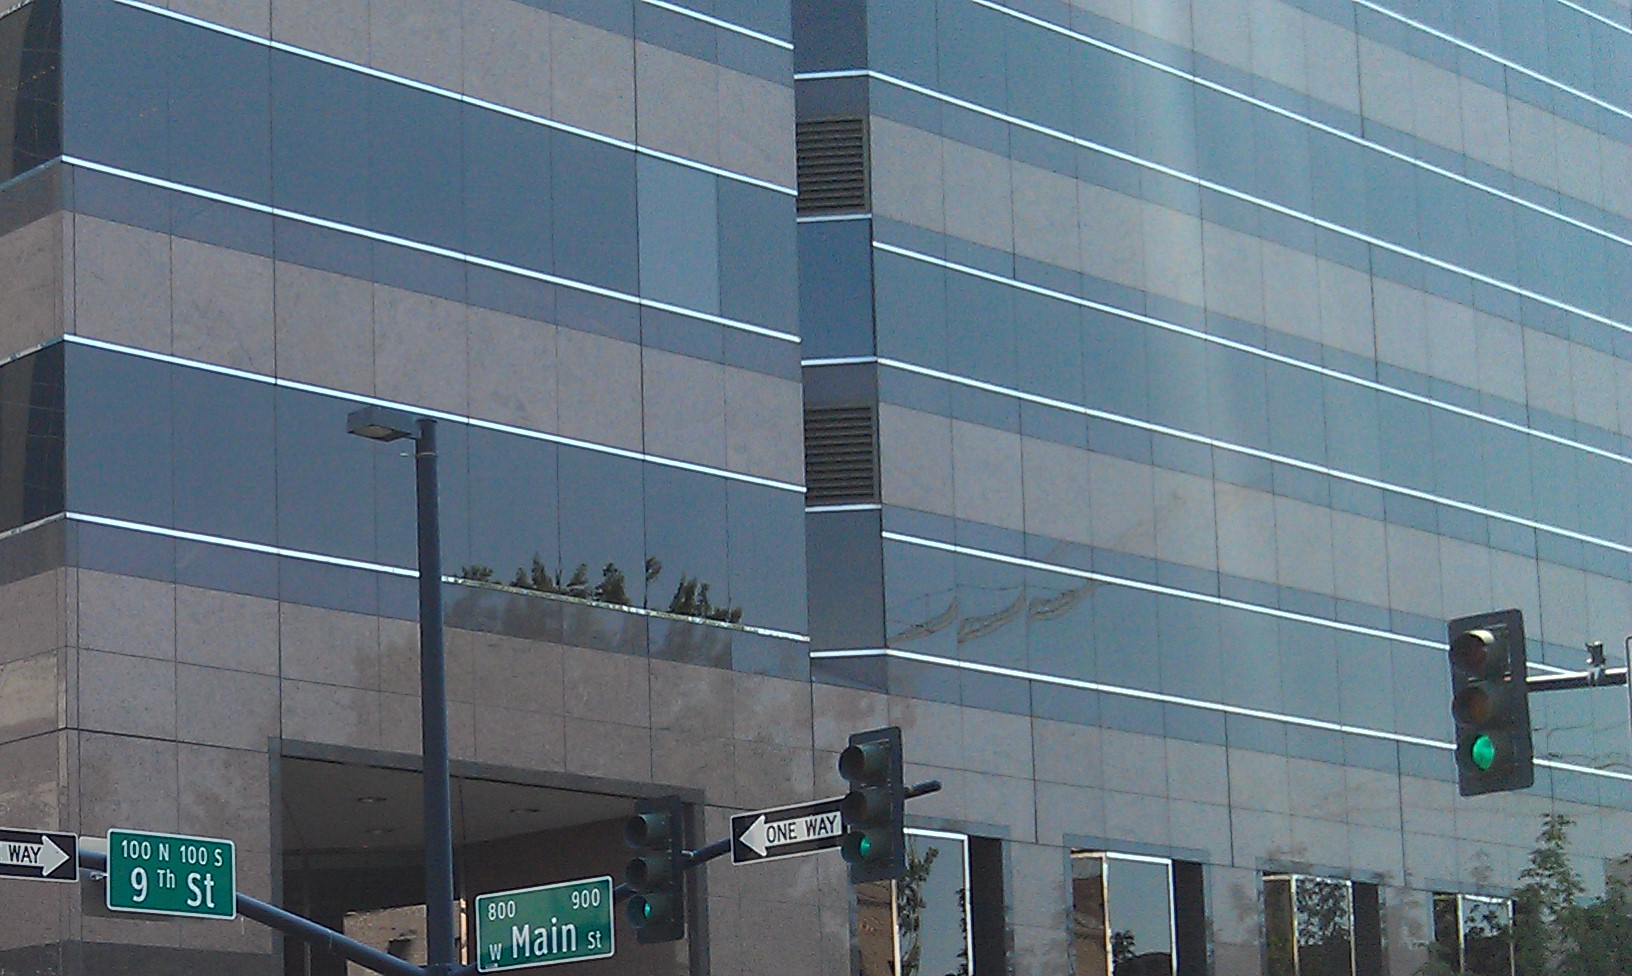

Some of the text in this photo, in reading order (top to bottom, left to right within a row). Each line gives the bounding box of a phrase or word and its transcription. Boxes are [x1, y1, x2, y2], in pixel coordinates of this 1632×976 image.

[767, 815, 838, 844] ONE WAY
[8, 844, 41, 864] WAY
[121, 839, 223, 867] 100 N 100 S
[186, 872, 215, 909] St
[487, 888, 601, 921] 800 900
[489, 917, 602, 960] W Main St
